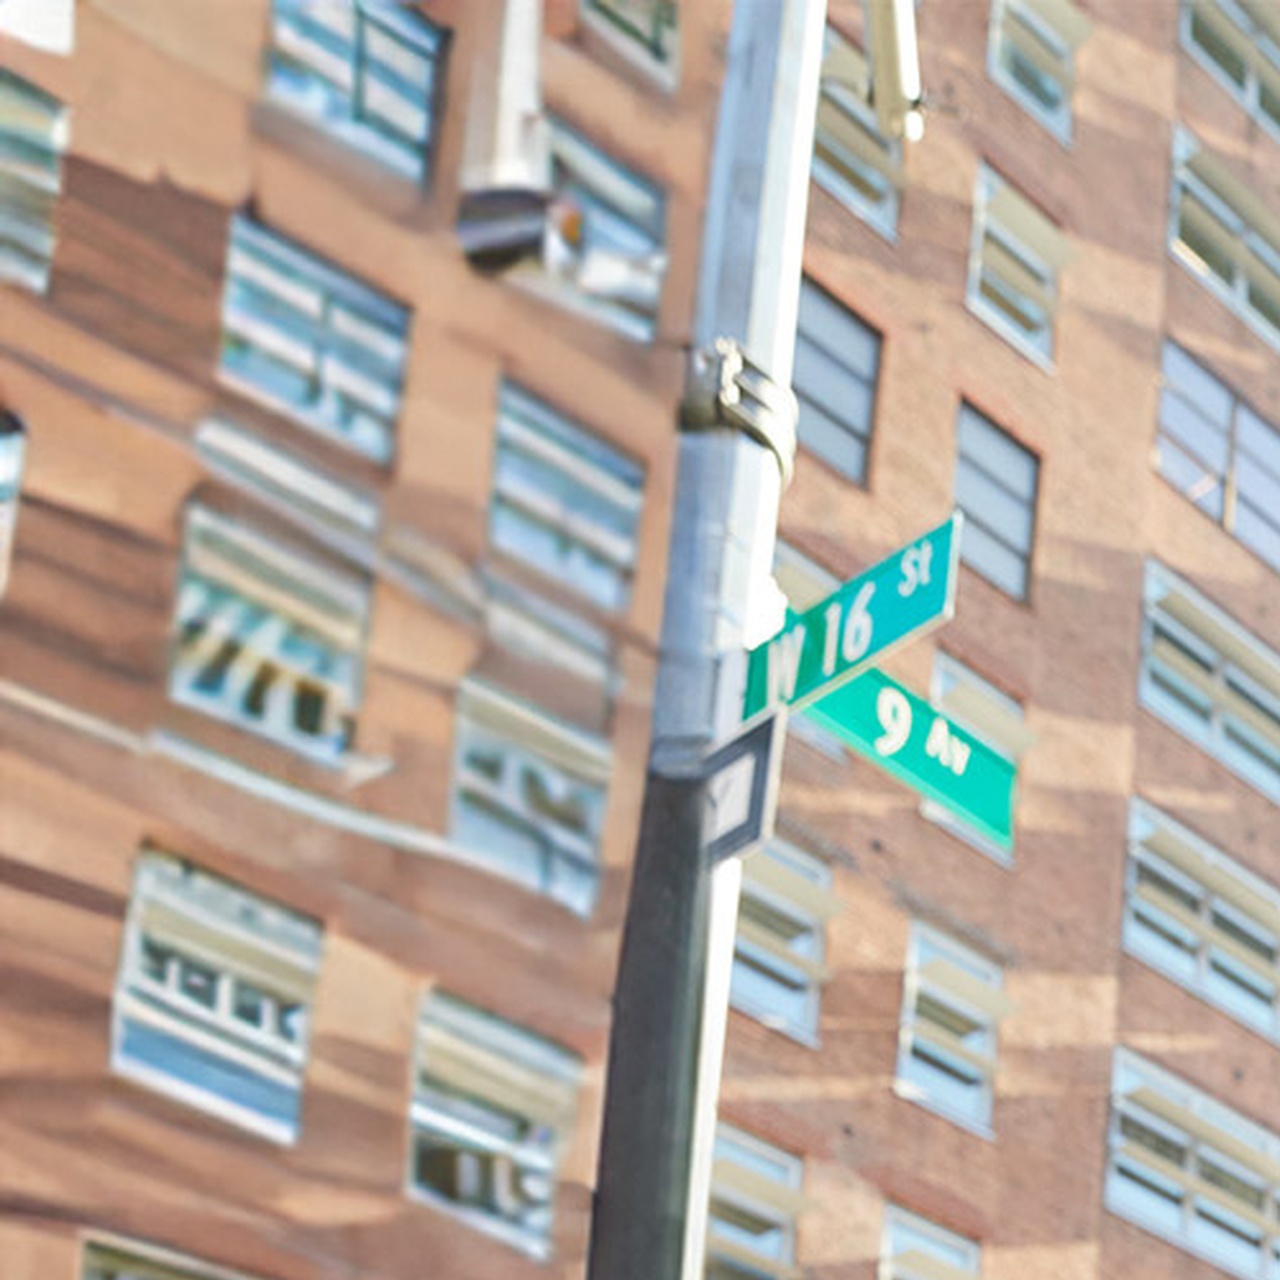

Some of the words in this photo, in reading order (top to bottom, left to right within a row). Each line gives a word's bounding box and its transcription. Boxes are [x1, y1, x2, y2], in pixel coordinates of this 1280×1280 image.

[767, 623, 806, 705] W
[822, 581, 876, 677] 16
[898, 540, 932, 597] St
[874, 687, 912, 756] 9
